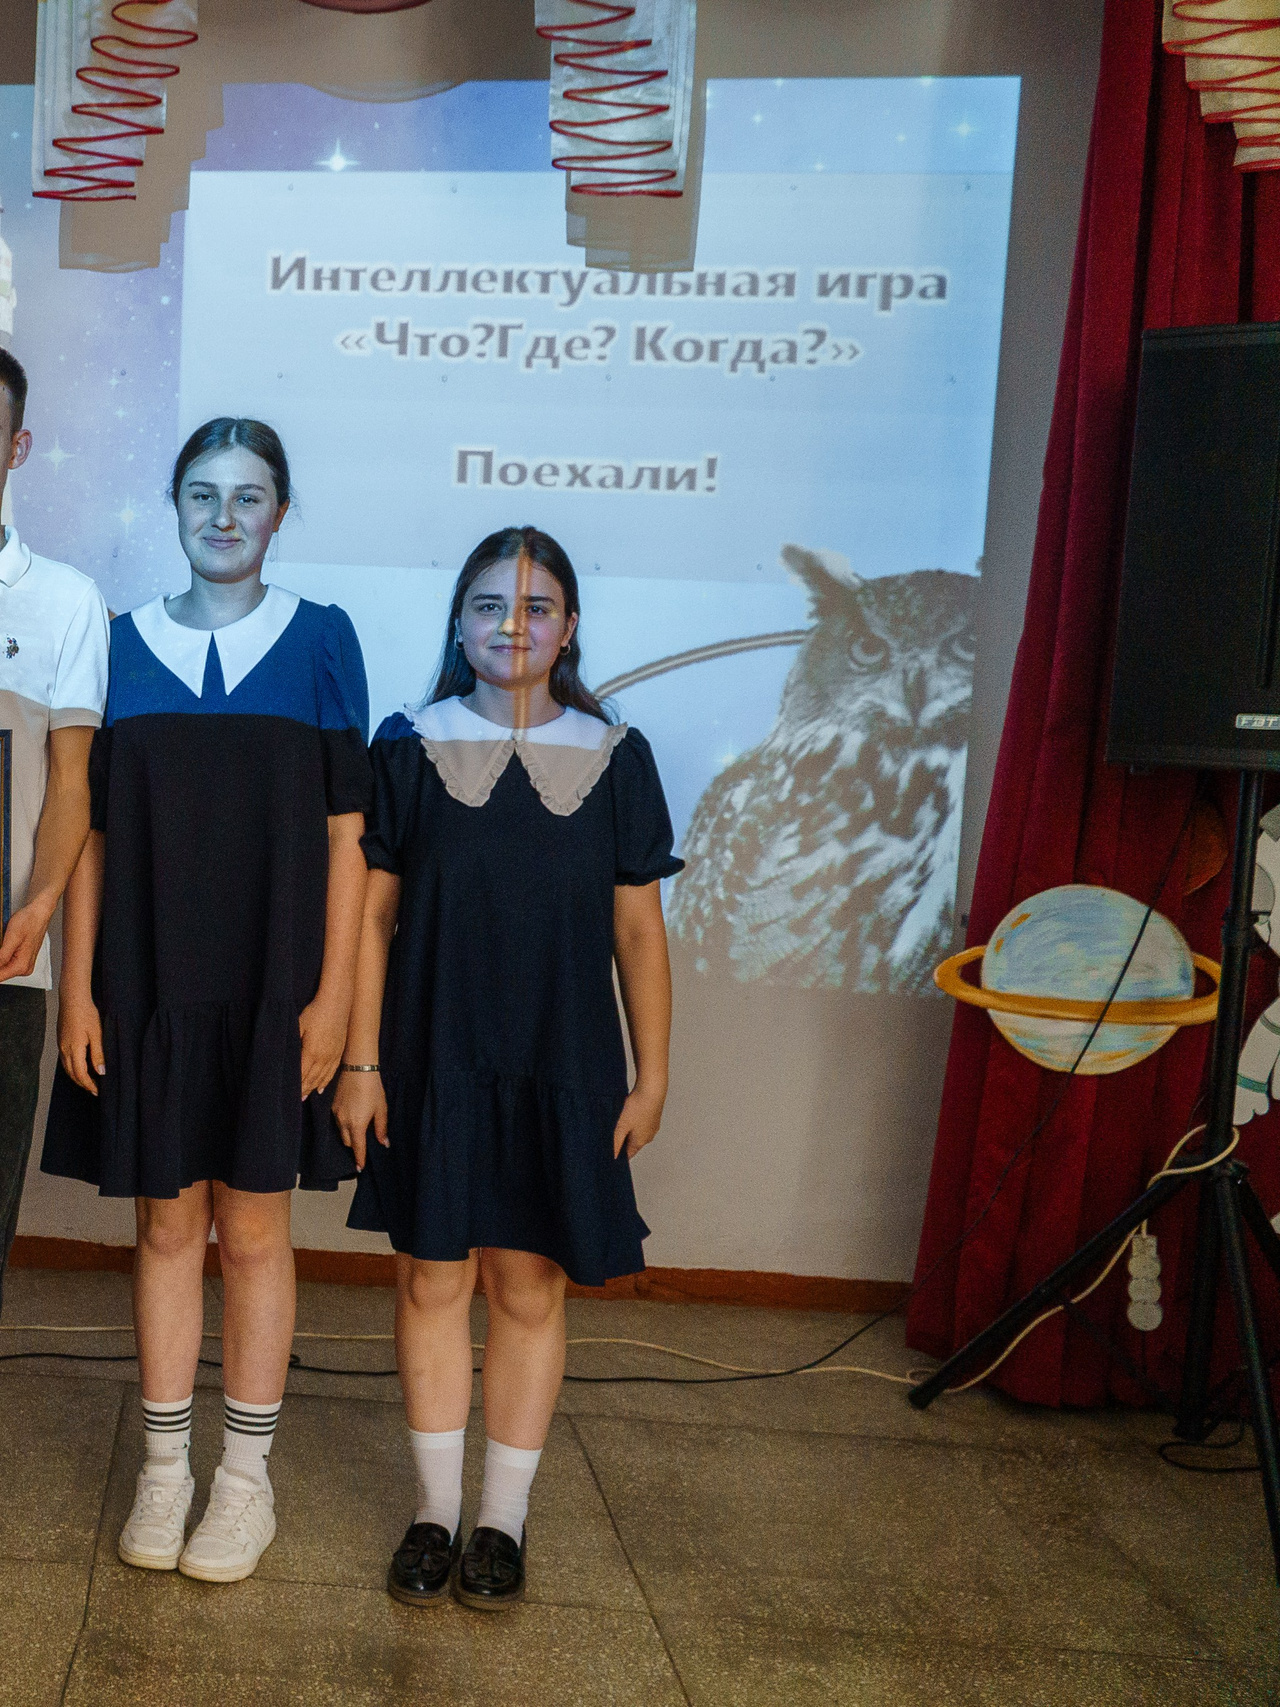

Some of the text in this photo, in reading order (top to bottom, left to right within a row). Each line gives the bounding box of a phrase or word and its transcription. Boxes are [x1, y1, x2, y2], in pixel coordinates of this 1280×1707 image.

[270, 254, 948, 312] Интеллектуальная игра
[455, 448, 719, 493] Поехали!
